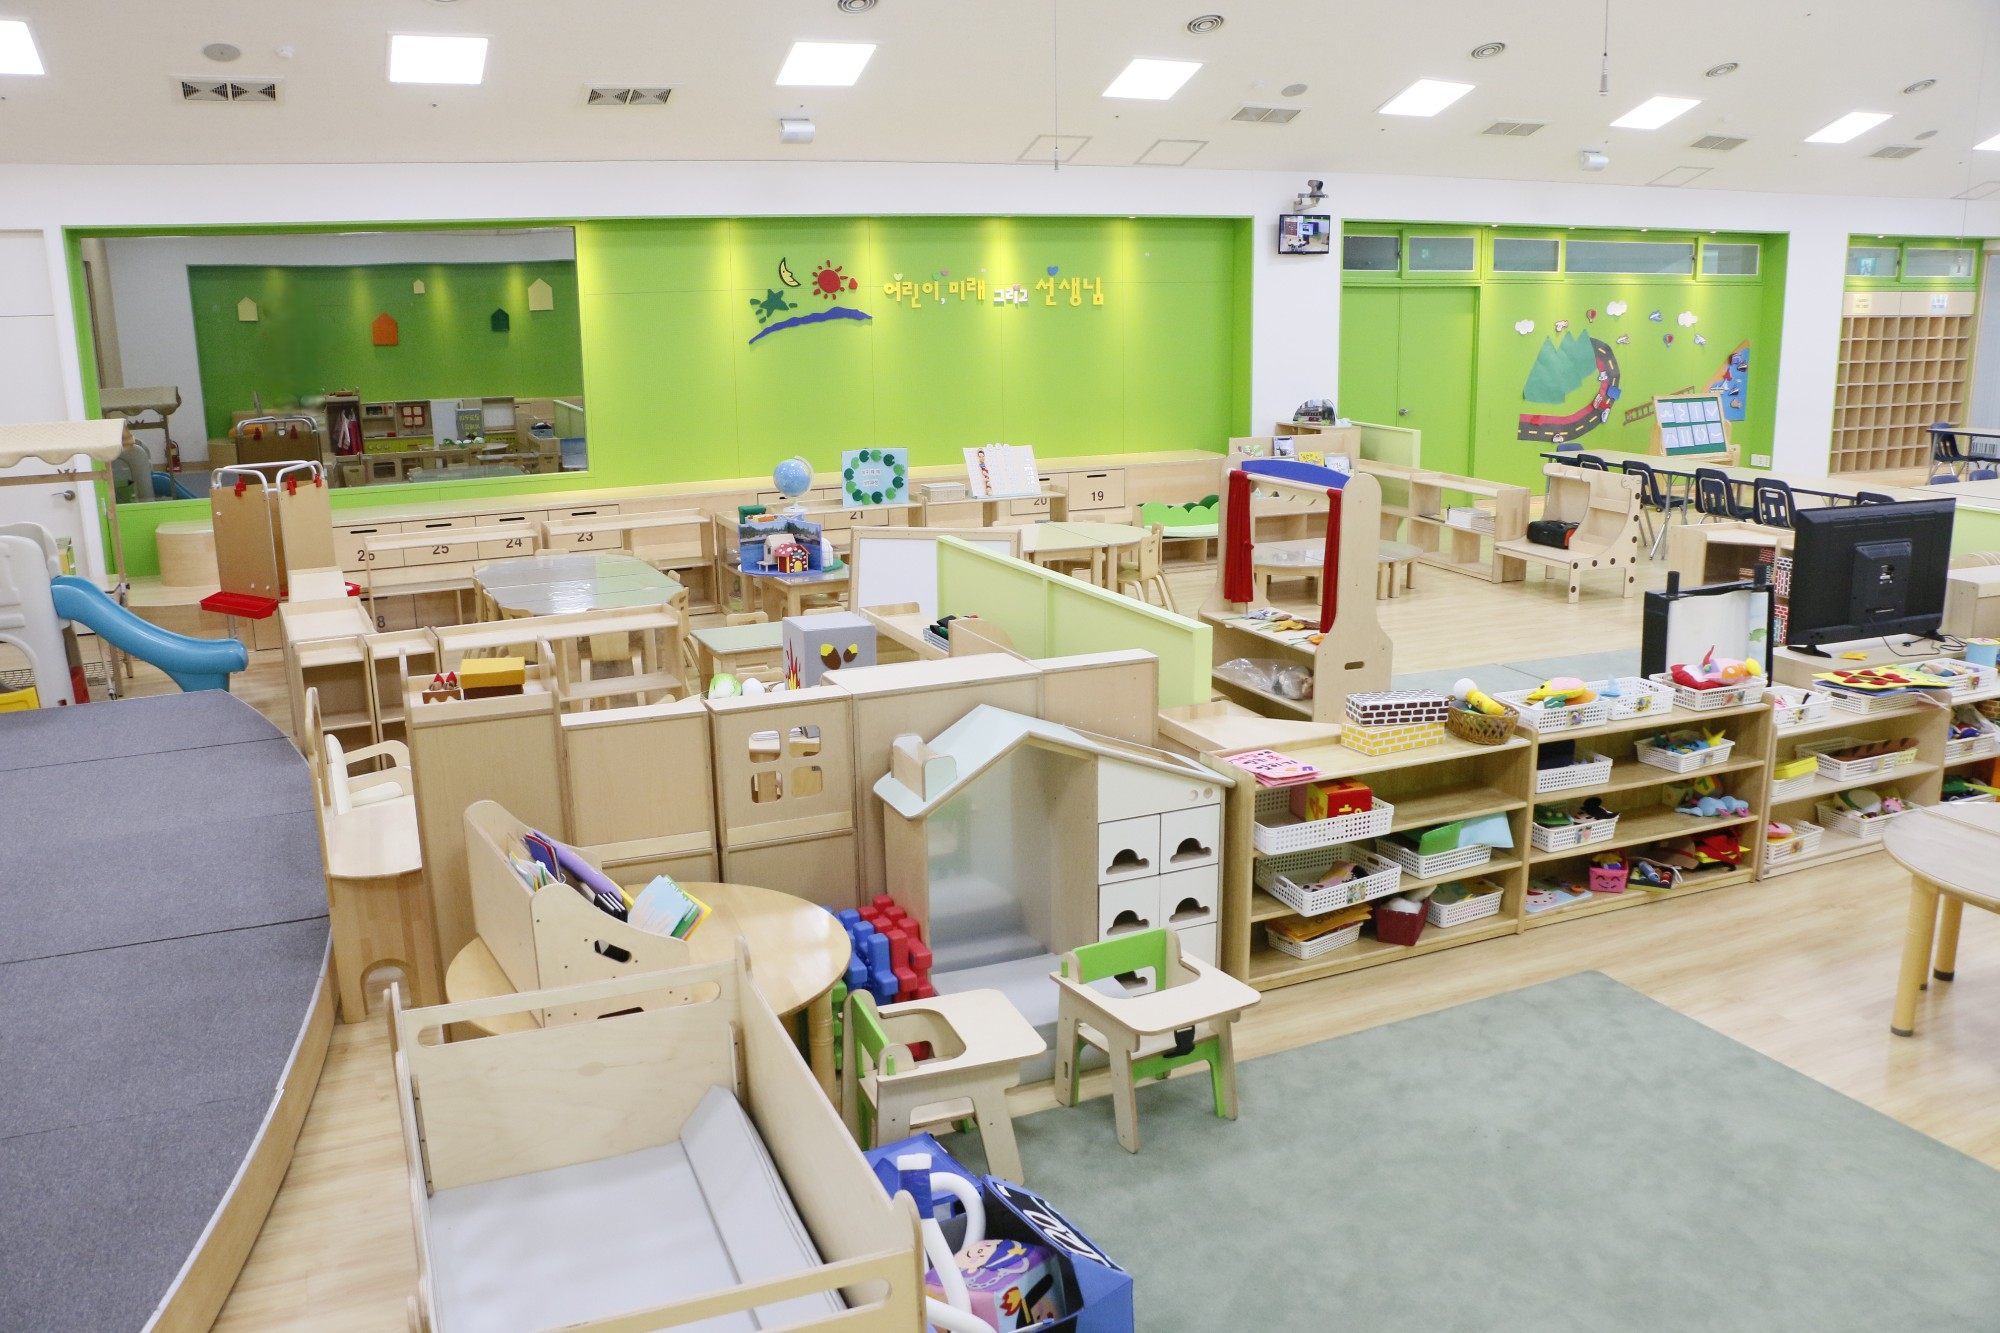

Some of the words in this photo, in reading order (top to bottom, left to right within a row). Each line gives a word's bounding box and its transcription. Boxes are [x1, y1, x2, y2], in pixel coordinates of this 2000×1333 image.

[883, 281, 945, 308] 어린이,
[949, 277, 985, 300] 미래
[993, 288, 1028, 304] 그리고
[1035, 277, 1104, 306] 선생님
[1091, 490, 1104, 501] 19
[850, 511, 864, 520] 21
[577, 532, 594, 542] 23
[505, 539, 522, 548] 24
[432, 545, 449, 555] 25
